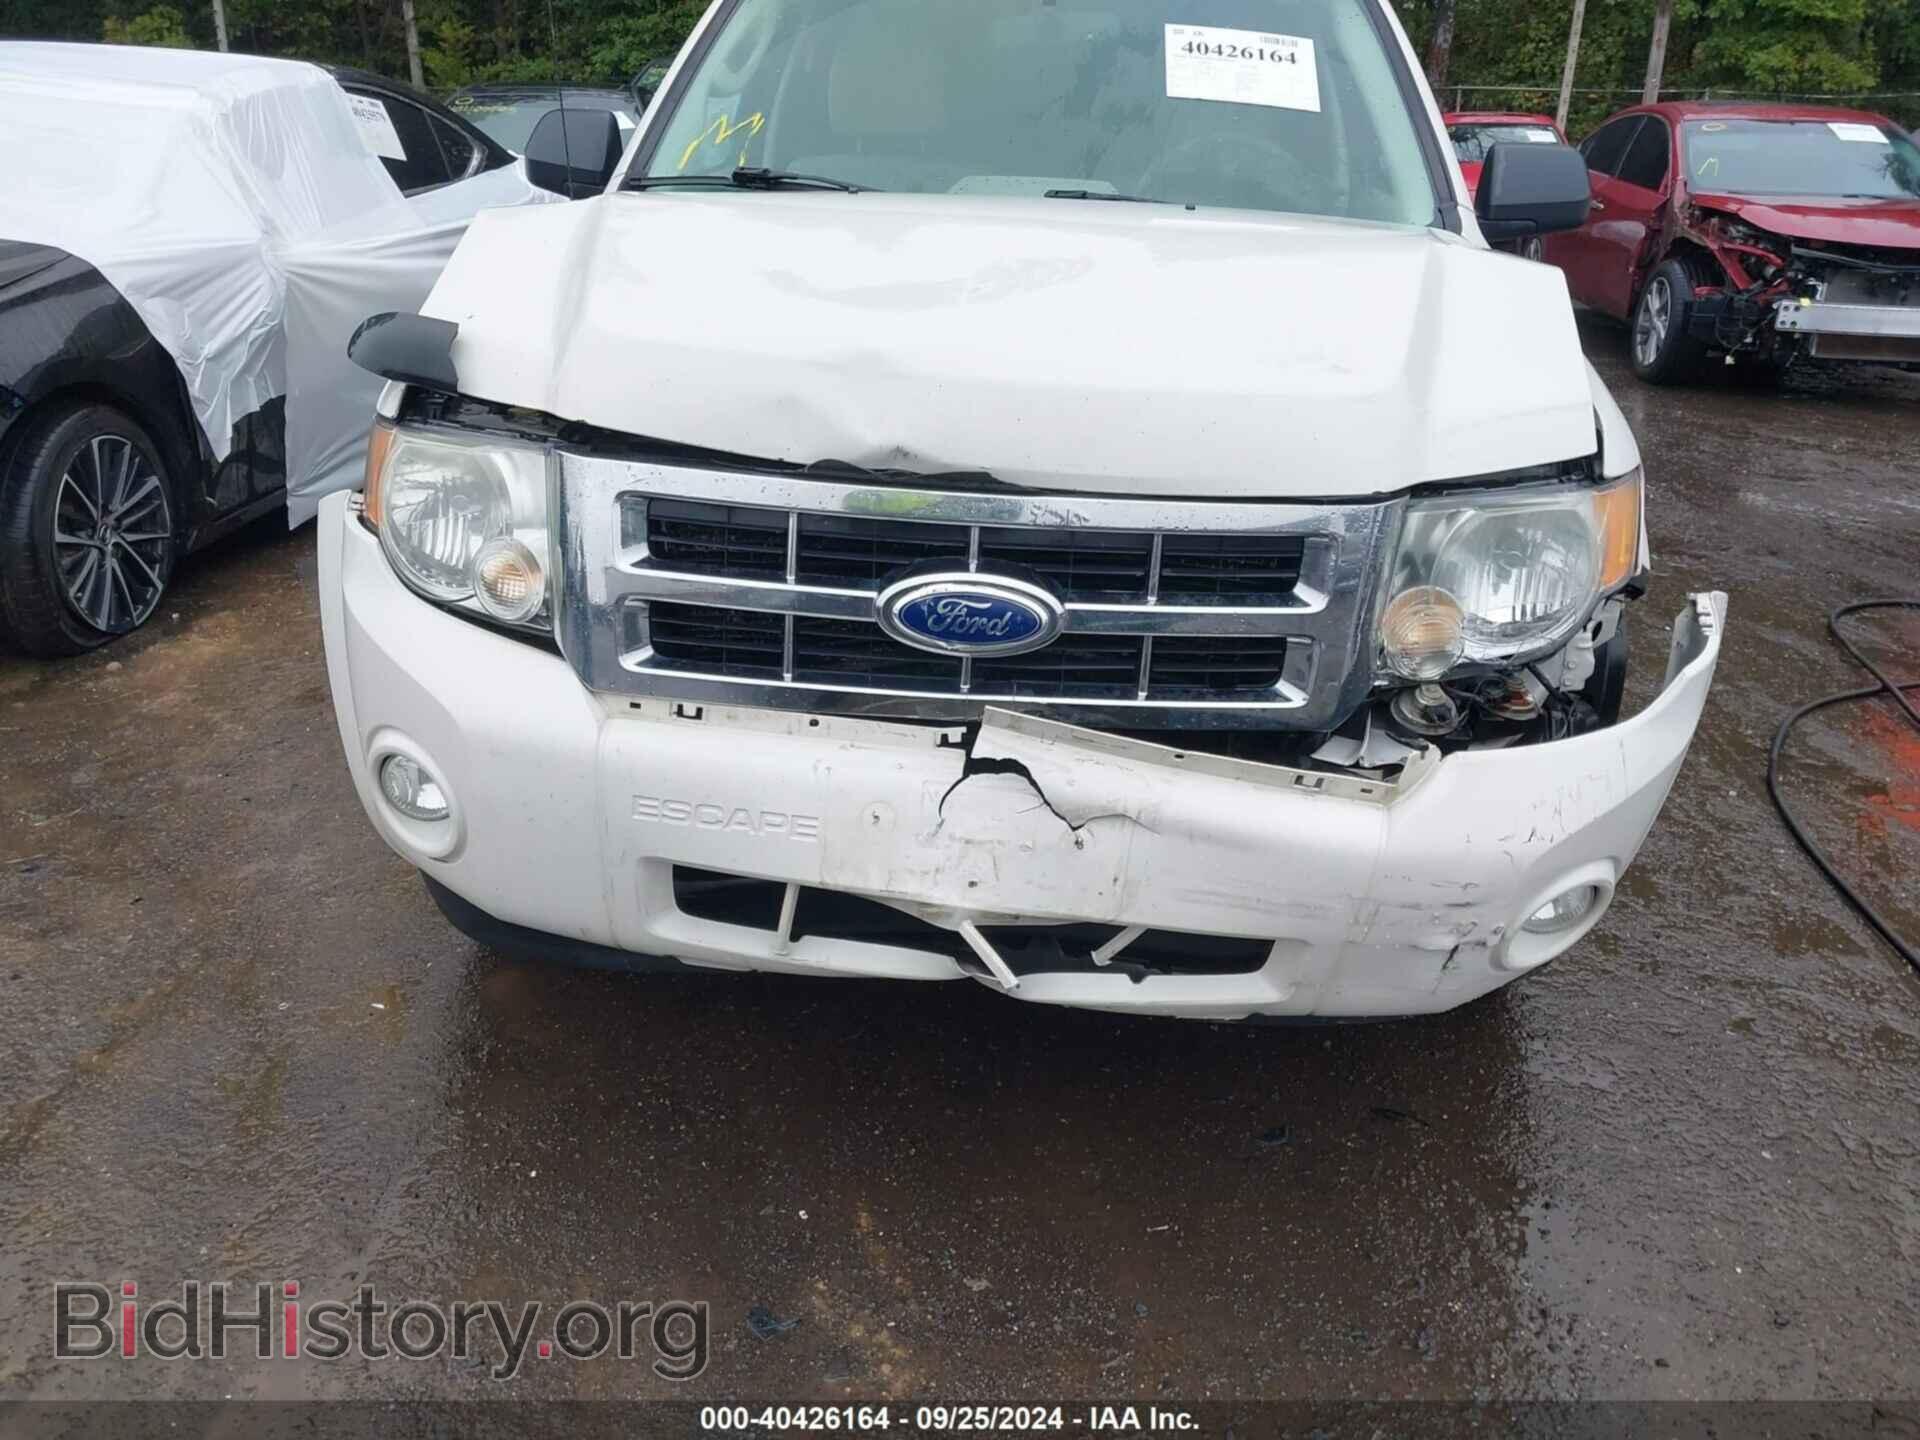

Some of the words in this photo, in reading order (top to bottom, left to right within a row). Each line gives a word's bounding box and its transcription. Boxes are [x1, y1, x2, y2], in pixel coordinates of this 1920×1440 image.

[1181, 40, 1297, 65] 40426164
[927, 598, 1012, 637] Ford
[632, 794, 819, 843] ESCAPE
